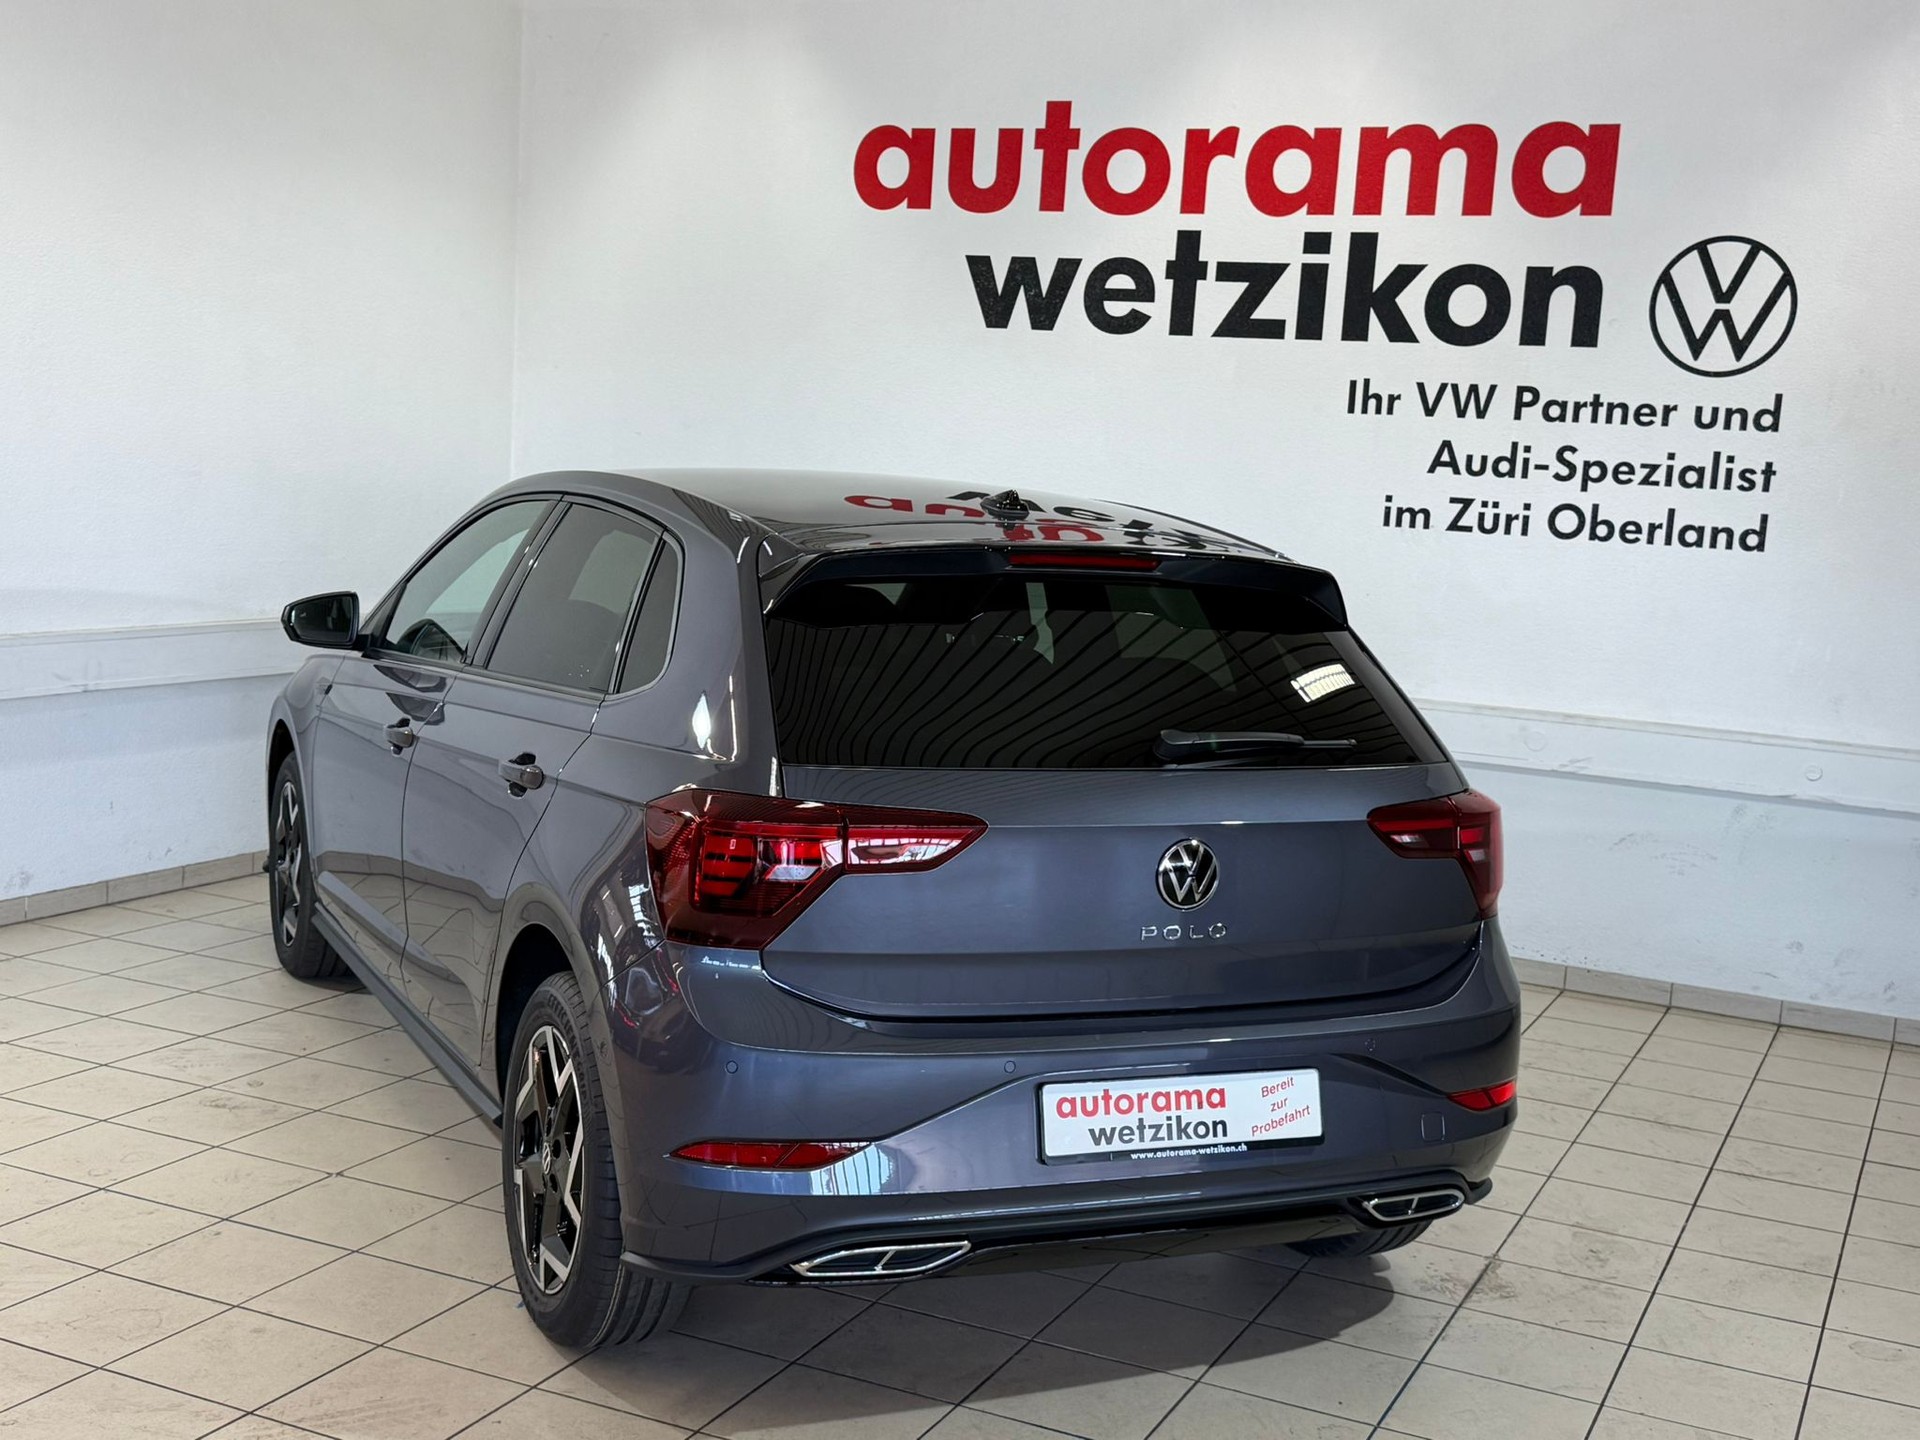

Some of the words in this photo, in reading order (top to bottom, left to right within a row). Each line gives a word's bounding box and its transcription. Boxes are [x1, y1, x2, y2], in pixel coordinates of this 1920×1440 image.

[854, 101, 1620, 217] autorama
[966, 230, 1603, 347] wetzikon
[1348, 380, 1402, 416] Ihr
[1417, 382, 1498, 420] VW
[1514, 386, 1678, 428] Partner
[1695, 394, 1782, 432] und
[1427, 440, 1776, 493] Audi-Spezialist
[1384, 495, 1430, 529] im
[1446, 497, 1531, 537] Züri
[1548, 504, 1768, 552] Oberland
[1140, 922, 1227, 941] POLO
[1056, 1087, 1226, 1119] autorama
[1261, 1076, 1295, 1098] Bereit
[1270, 1096, 1289, 1113] zur
[1088, 1115, 1227, 1146] wetzikon
[1251, 1105, 1311, 1137] Probefahrt
[1130, 1142, 1248, 1160] www.autorama-wetzikon.ch
